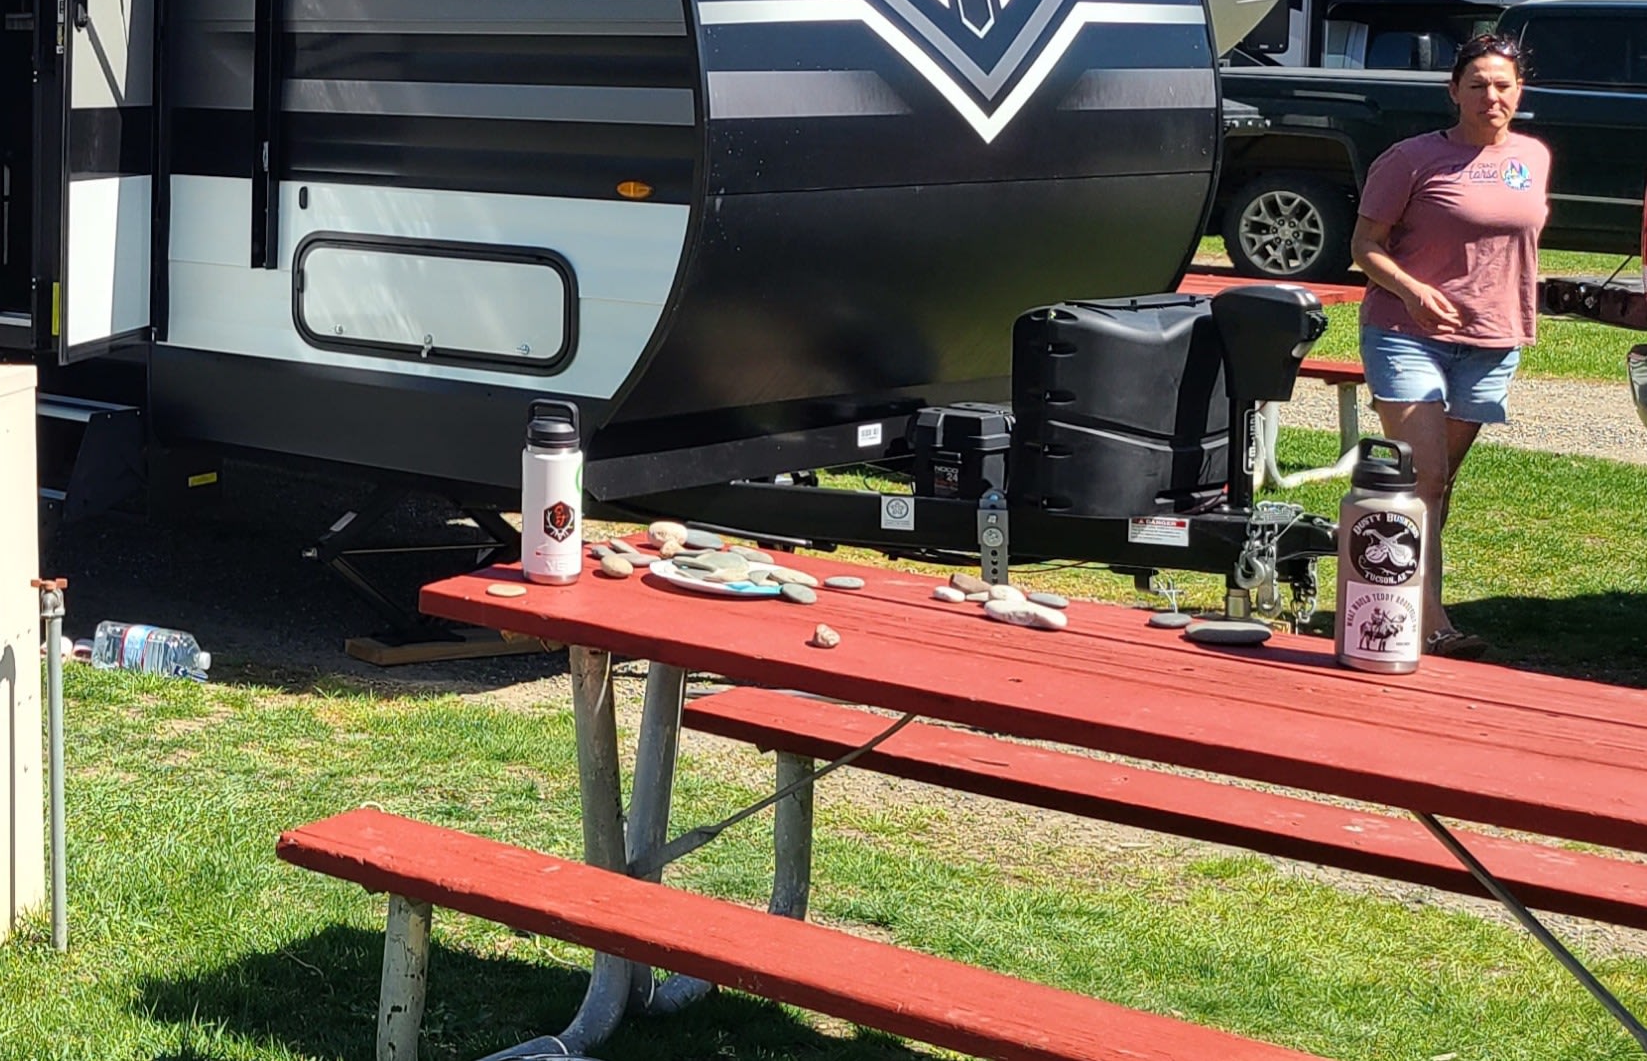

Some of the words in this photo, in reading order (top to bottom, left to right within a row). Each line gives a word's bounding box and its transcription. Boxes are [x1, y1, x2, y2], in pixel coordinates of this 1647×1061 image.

[945, 472, 959, 482] 24
[1352, 513, 1382, 536] DUSTY
[1371, 592, 1395, 602] TEDDY
